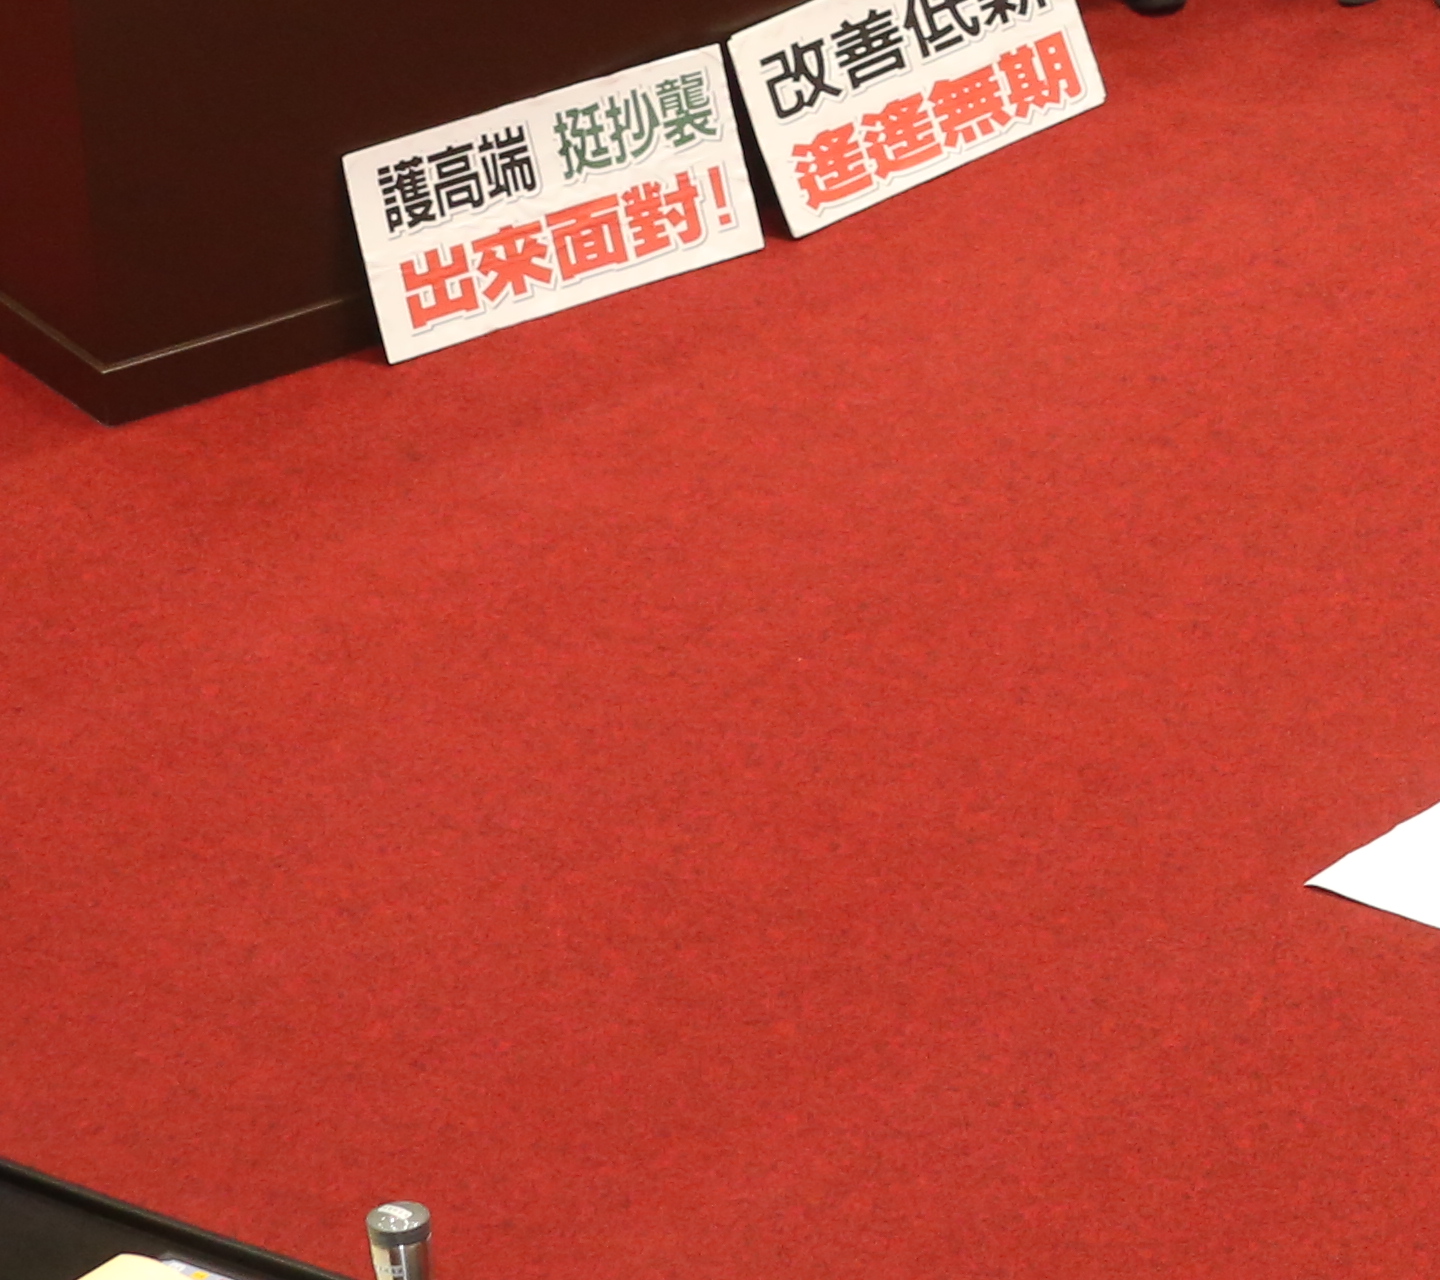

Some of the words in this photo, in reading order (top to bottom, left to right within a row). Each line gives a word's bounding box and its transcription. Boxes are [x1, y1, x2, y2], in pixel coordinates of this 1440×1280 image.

[378, 125, 537, 233] 護高端
[553, 70, 718, 181] 挺抄襲
[791, 32, 1082, 212] 遙遙無期
[400, 167, 734, 329] 出來面對!
